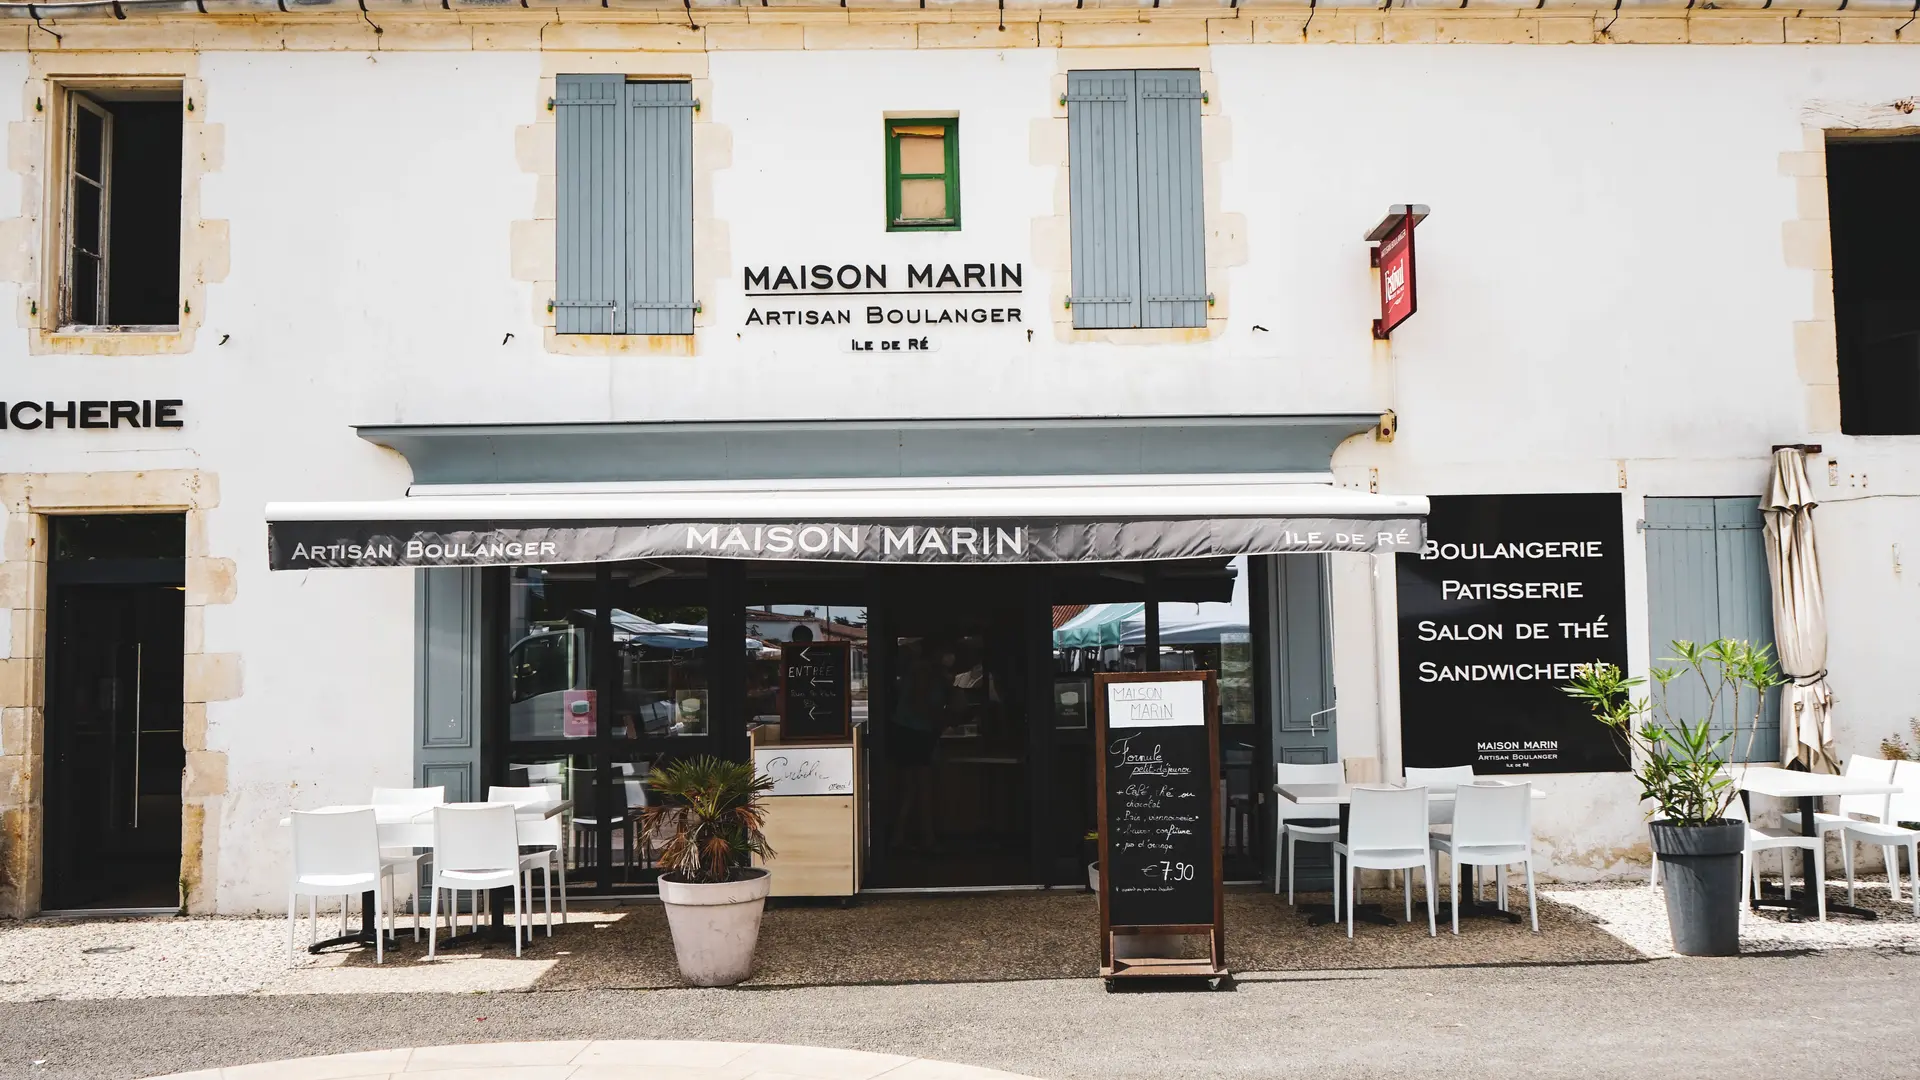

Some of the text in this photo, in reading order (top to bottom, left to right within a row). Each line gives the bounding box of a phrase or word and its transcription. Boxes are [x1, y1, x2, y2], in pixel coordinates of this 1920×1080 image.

[744, 262, 1023, 290] MAISON MARIN
[744, 306, 1022, 325] ARTISAN BOULANGER
[851, 336, 930, 351] ILE DE RÉ
[0, 399, 184, 430] ICHERIE
[685, 526, 1022, 555] MAISON MARIN
[1284, 527, 1411, 546] ILE DE RÉ
[291, 540, 556, 560] ARTISAN BOULANGER
[1420, 539, 1604, 560] BOULANGERIE
[1442, 579, 1584, 600] PATISSERIE
[1417, 614, 1609, 642] SALON DE THÉ
[1113, 687, 1163, 701] MAISON
[1130, 703, 1174, 720] MARIN
[1477, 740, 1558, 751] MAISON MARIN
